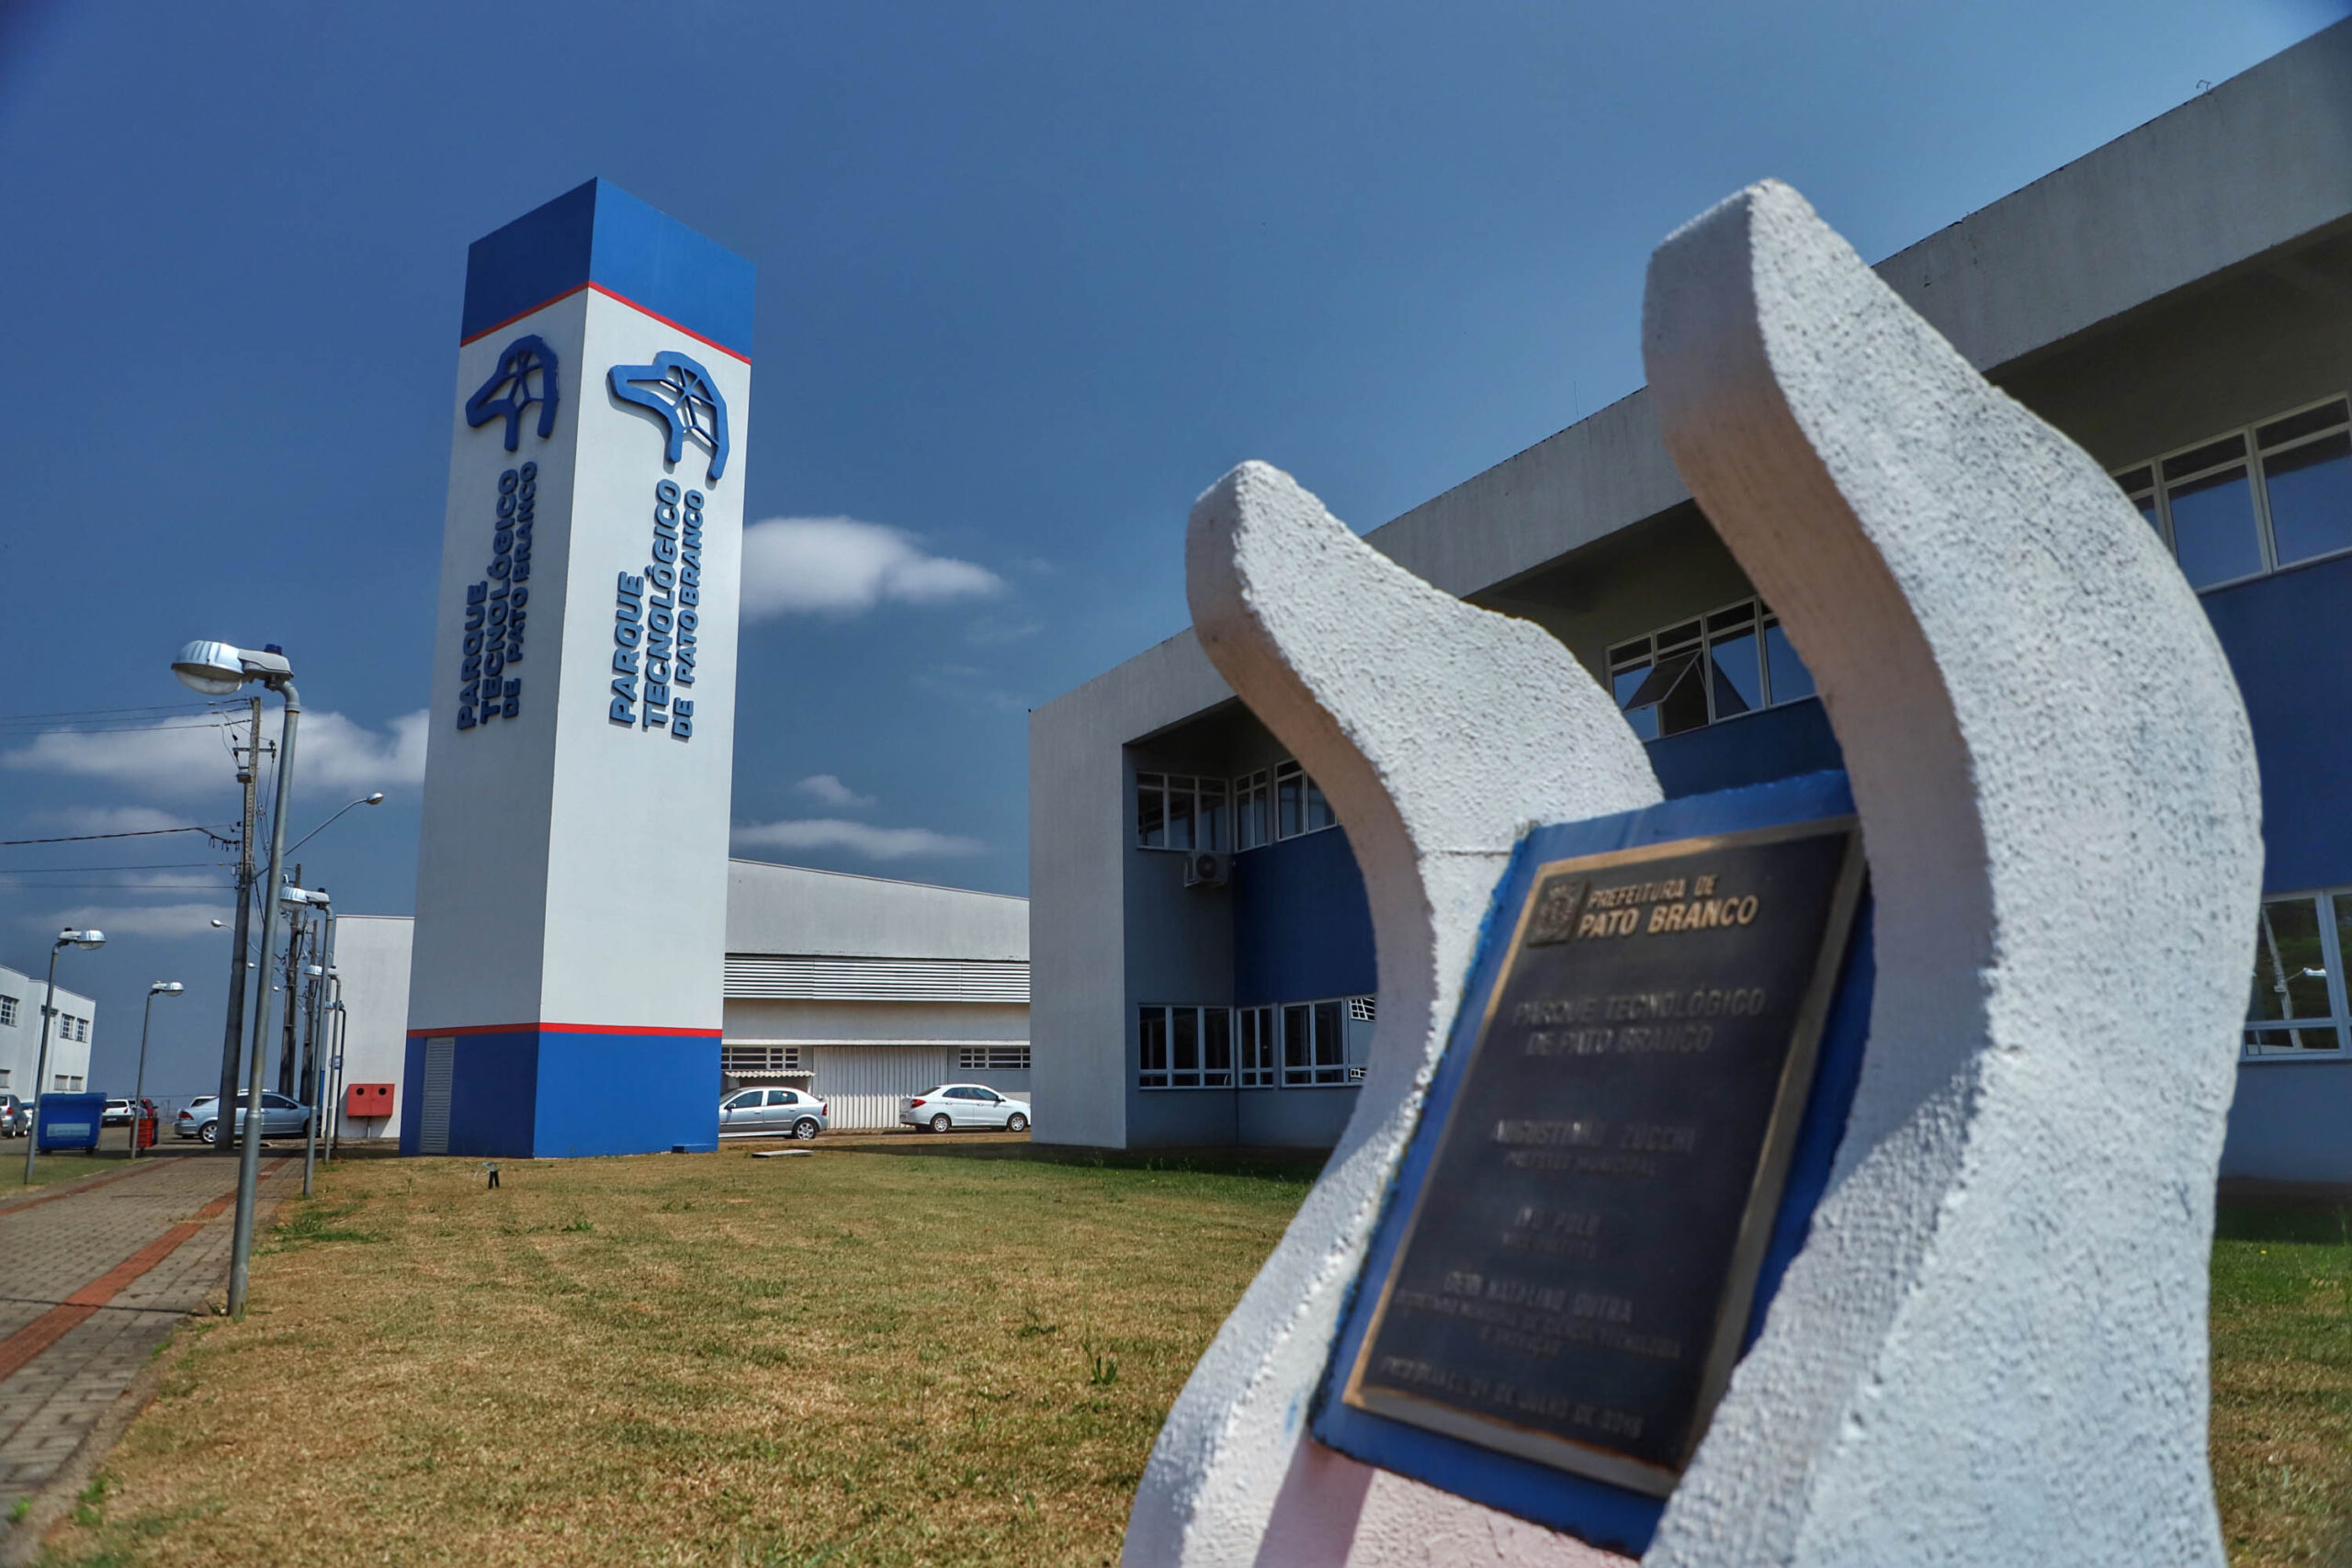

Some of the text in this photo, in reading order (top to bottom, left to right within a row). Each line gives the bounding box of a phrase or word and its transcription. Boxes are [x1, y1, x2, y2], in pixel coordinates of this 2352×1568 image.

[457, 581, 488, 729] PARQUE
[480, 469, 519, 724] TECNOLÓGICO
[502, 461, 538, 718] DE PATO BRANCO
[610, 570, 644, 724] PARQUE
[643, 479, 681, 728] TECNOLÓGICO
[672, 490, 705, 739] DE PATO BRANCO
[1578, 895, 1758, 938] PATO BRANCO
[1588, 874, 1716, 908] PREFEITURA DE
